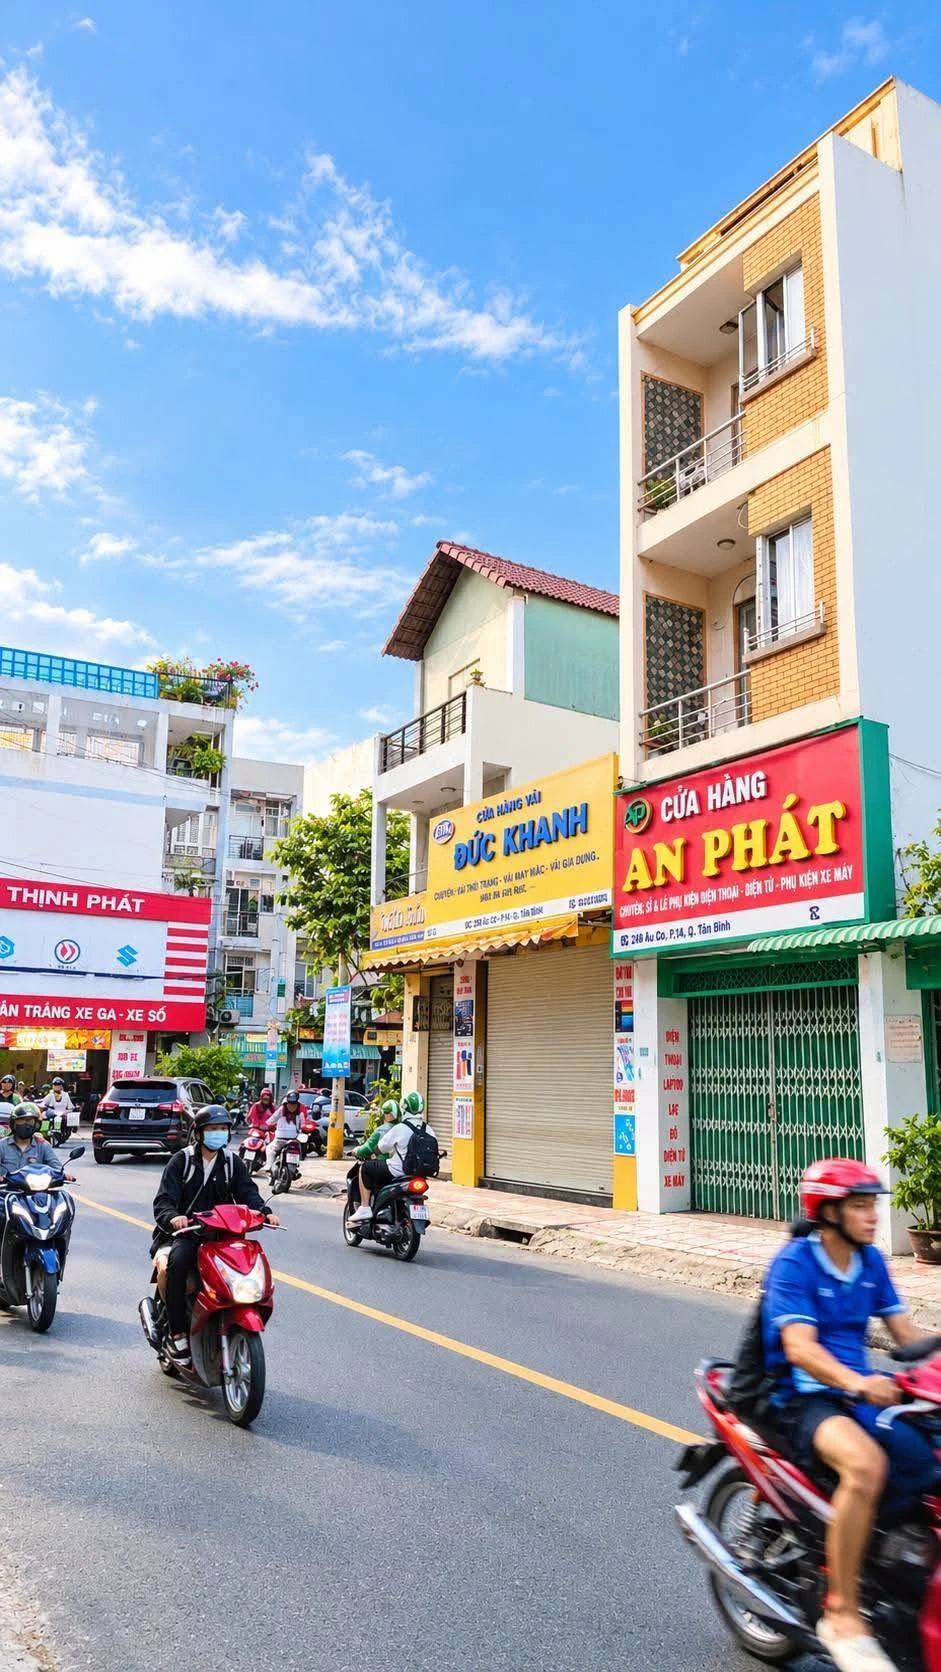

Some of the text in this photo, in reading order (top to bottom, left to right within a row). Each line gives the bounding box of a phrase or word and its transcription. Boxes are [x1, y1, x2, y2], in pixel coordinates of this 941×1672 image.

[660, 771, 768, 822] CỬA HÀNG
[454, 803, 588, 871] ĐỨC KHANH
[622, 793, 847, 892] AN PHÁT
[562, 856, 575, 869] GIA
[780, 873, 797, 893] PHỤ
[799, 869, 818, 890] KIỆN
[820, 869, 832, 884] XE
[834, 862, 853, 881] MÁY
[7, 886, 145, 913] THỊNH PHÁT
[74, 1007, 94, 1020] XE
[97, 1007, 117, 1021] GA
[125, 1008, 144, 1022] XE
[147, 1005, 167, 1023] SỐ
[663, 1175, 672, 1188] XE
